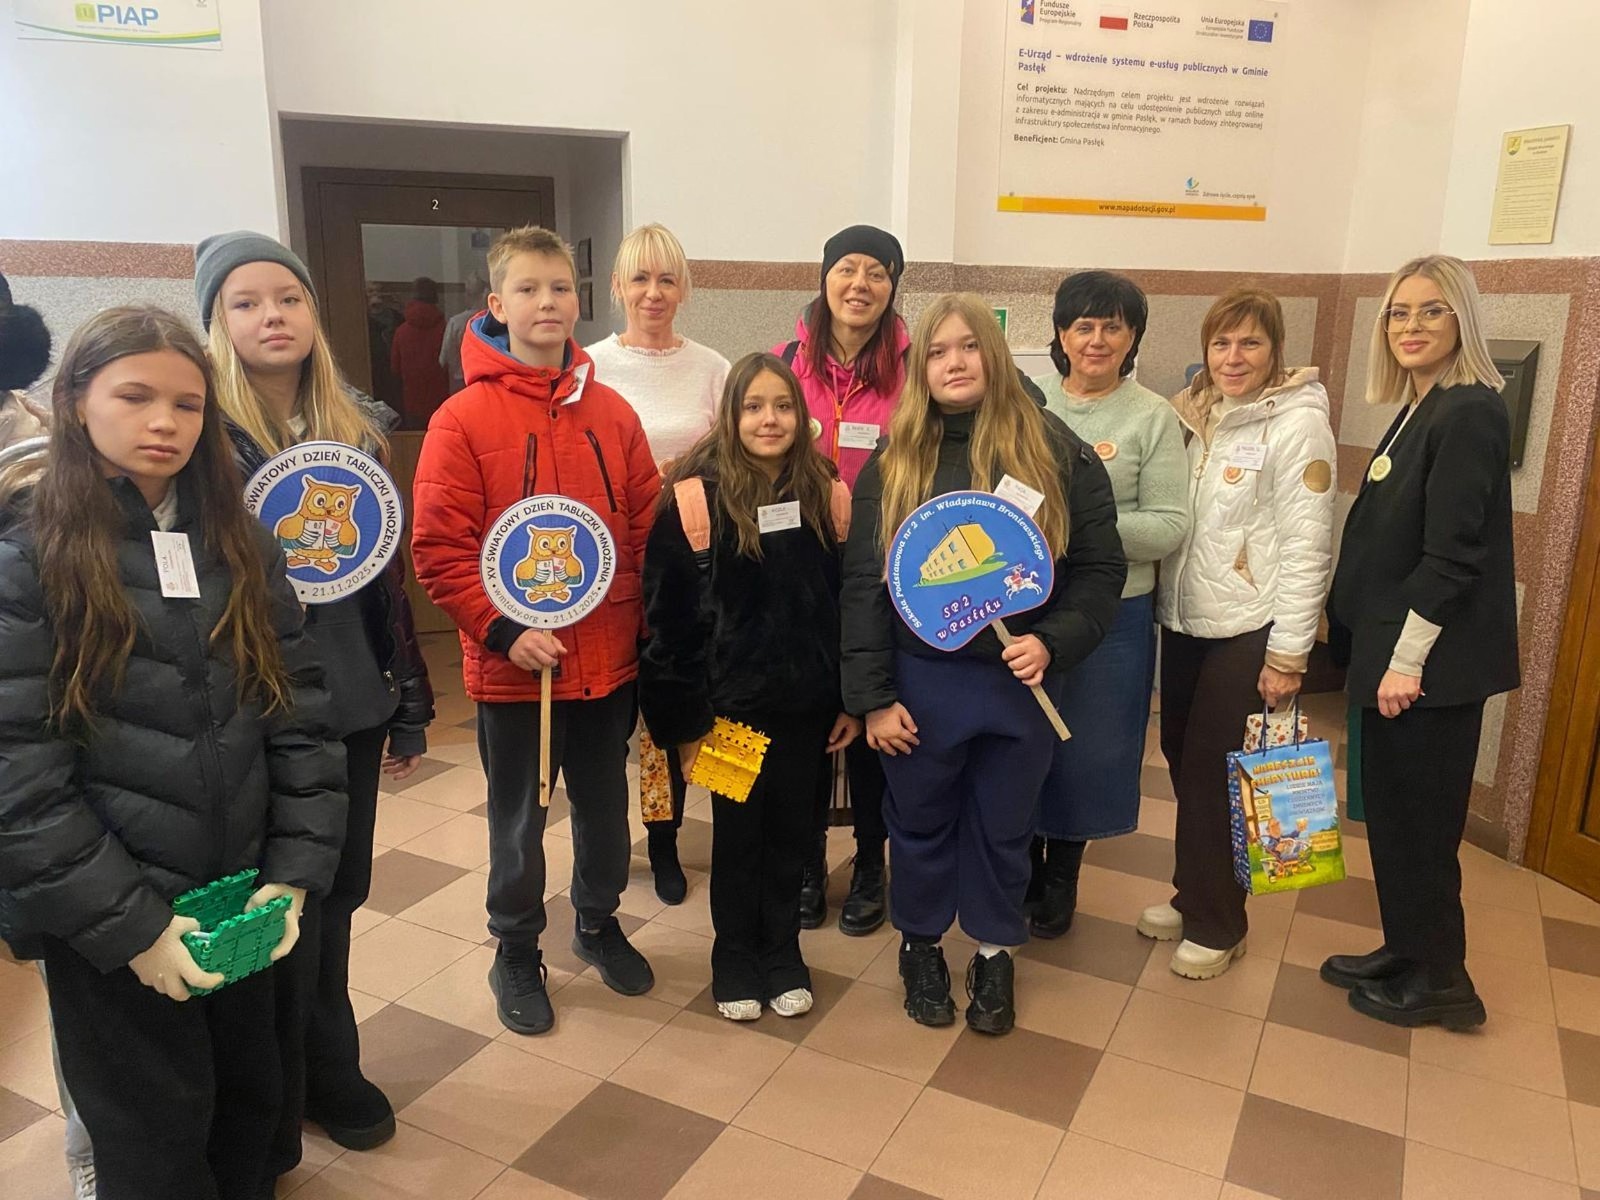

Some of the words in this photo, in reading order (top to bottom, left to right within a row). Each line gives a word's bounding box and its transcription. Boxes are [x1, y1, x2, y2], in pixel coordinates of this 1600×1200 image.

[97, 4, 159, 26] PIAP
[1039, 8, 1076, 18] Europejskie
[1040, 0, 1070, 9] Fundusze
[1132, 20, 1154, 29] Polska
[1133, 12, 1180, 24] Rzeczpospolita
[1201, 16, 1213, 24] Unia
[1214, 17, 1244, 27] Europejska
[1018, 48, 1052, 61] E-Urząd
[1066, 53, 1107, 64] wdrożenie
[1112, 57, 1145, 67] systemu
[1150, 60, 1179, 71] e-usług
[1182, 62, 1228, 74] publicznych
[1242, 66, 1269, 77] Gminie
[1018, 62, 1046, 74] Pasłęk
[1016, 83, 1028, 91] Cel
[1035, 85, 1068, 94] projektu:
[1074, 87, 1115, 98] Nadrzędnym
[1146, 92, 1174, 102] projektu
[1179, 96, 1191, 104] jest
[1197, 97, 1229, 106] wdrożenie
[1234, 100, 1265, 109] rozwiązań
[1016, 94, 1071, 106] informatycznych
[1074, 99, 1105, 109] mających
[1120, 102, 1134, 110] celu
[1137, 104, 1183, 114] udostępnienie
[1186, 108, 1222, 117] publicznych
[1225, 110, 1242, 118] usług
[1015, 116, 1062, 128] infrastruktury
[1062, 120, 1110, 130] społeczeństwa
[1016, 106, 1020, 114] z
[1022, 106, 1048, 115] zakresu
[1111, 113, 1133, 122] gminie
[1168, 116, 1191, 124] ramach
[1193, 118, 1218, 128] budowy
[1220, 120, 1263, 130] zintegrowanej
[1014, 134, 1058, 144] Beneficjent:
[1060, 136, 1082, 144] Gmina
[1082, 138, 1104, 147] Pasłęk
[432, 199, 439, 210] 2
[1098, 203, 1176, 214] www.mapadotacji.gov.pl
[303, 450, 341, 464] DZIEŃ
[346, 455, 390, 496] TABLICZKI
[375, 500, 397, 560] MNOŻENIA
[524, 500, 554, 516] DZIEŃ
[936, 496, 996, 510] Władysława
[559, 502, 601, 531] TABLICZKI
[912, 521, 919, 530] 2
[487, 511, 520, 562] ŚWIATOWY
[903, 530, 912, 541] nr
[997, 504, 1045, 561] Broniewskiego
[598, 532, 612, 583] MNOŻENIA
[487, 566, 497, 580] XV
[892, 540, 906, 598] Podstawowa
[312, 566, 372, 597] 21.11.2025
[494, 589, 540, 624] wmtday.org
[553, 592, 599, 624] 21.11.2025
[899, 596, 922, 629] Szkoła
[936, 631, 948, 640] w
[950, 600, 1001, 633] Pasłęku
